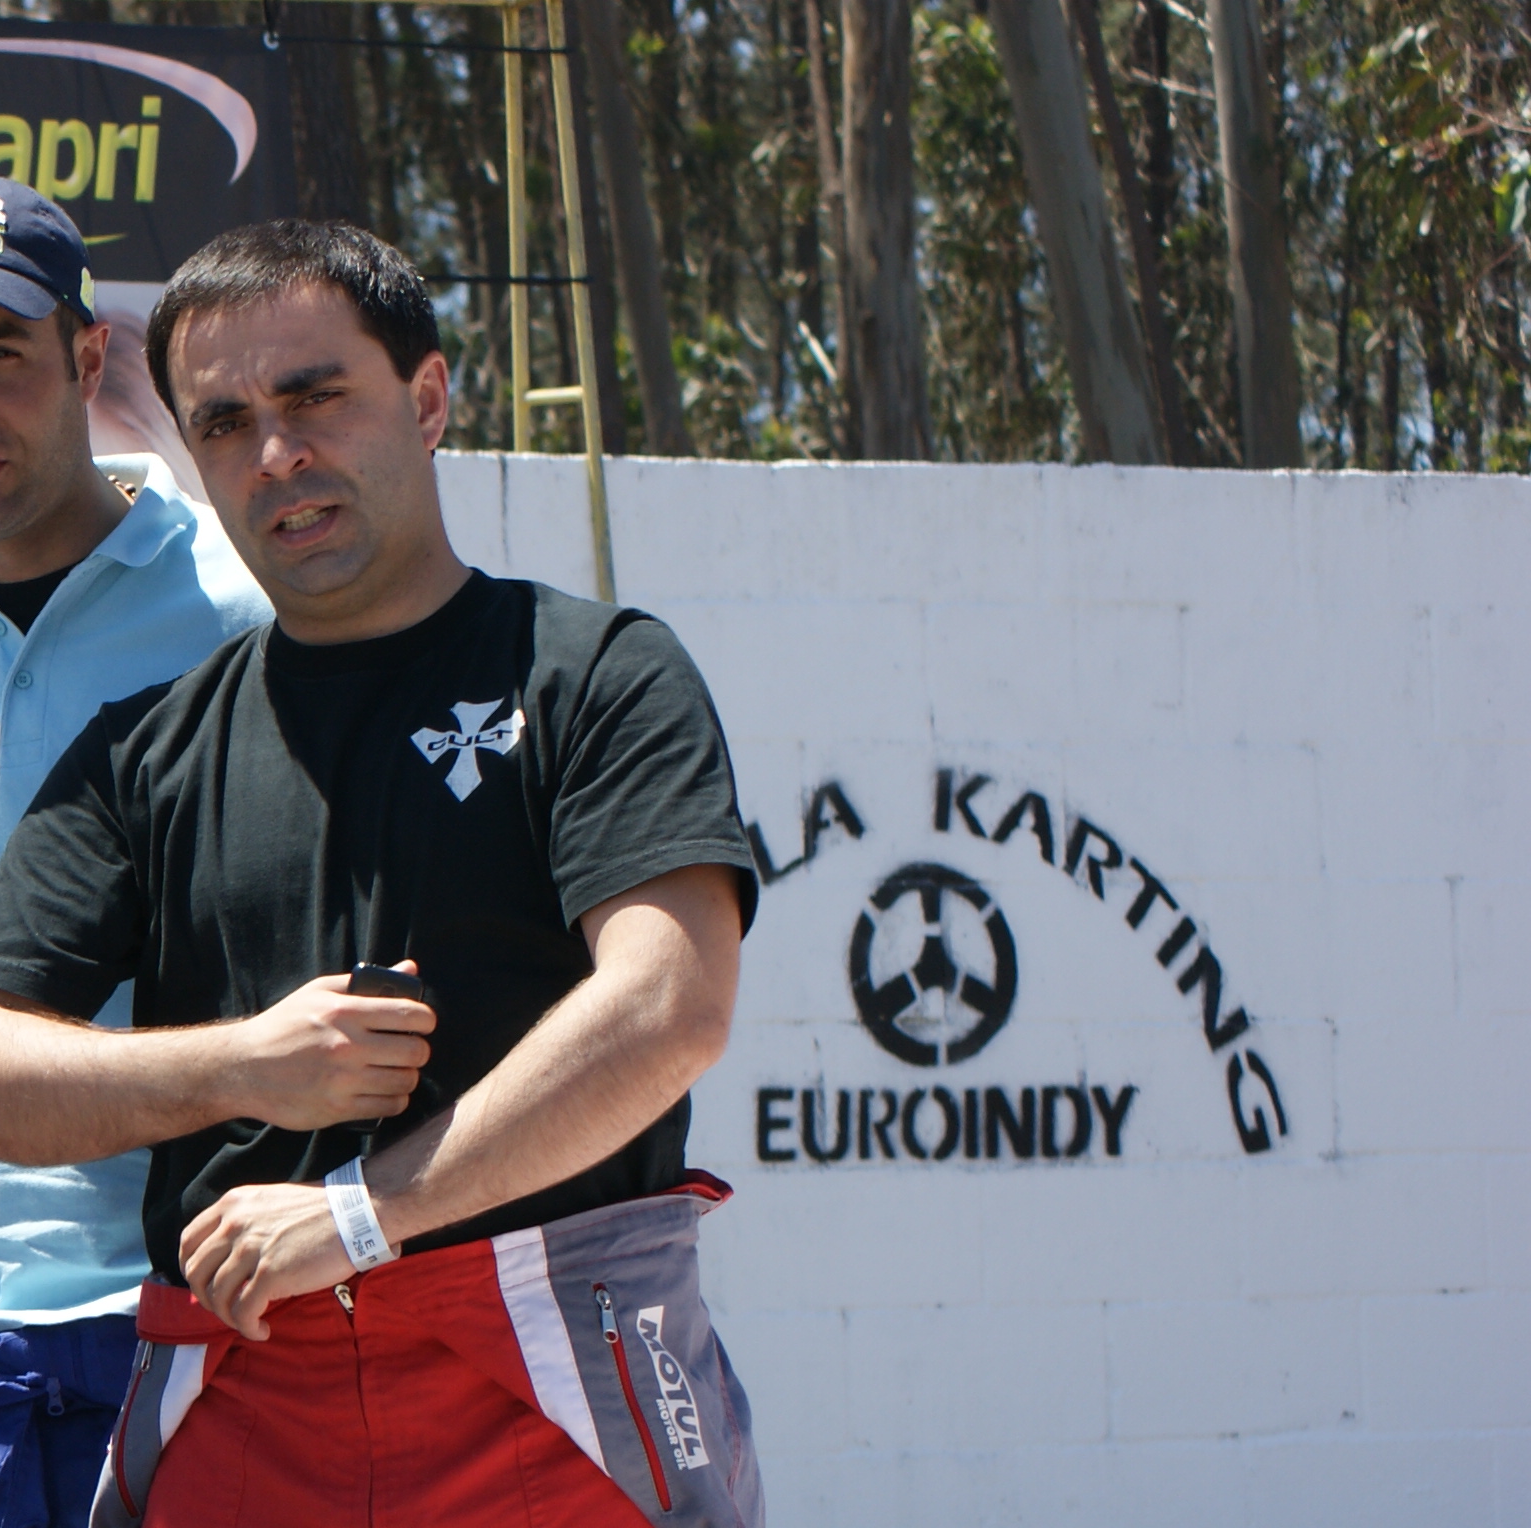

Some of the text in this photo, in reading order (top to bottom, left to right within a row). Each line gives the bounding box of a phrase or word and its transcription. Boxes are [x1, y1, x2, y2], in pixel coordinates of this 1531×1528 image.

[427, 728, 514, 751] CULT
[934, 766, 1290, 1154] KARTING
[755, 1085, 1140, 1164] EUROINDY
[639, 1316, 703, 1458] MOTUL
[655, 1398, 688, 1471] MOTOR OIL
